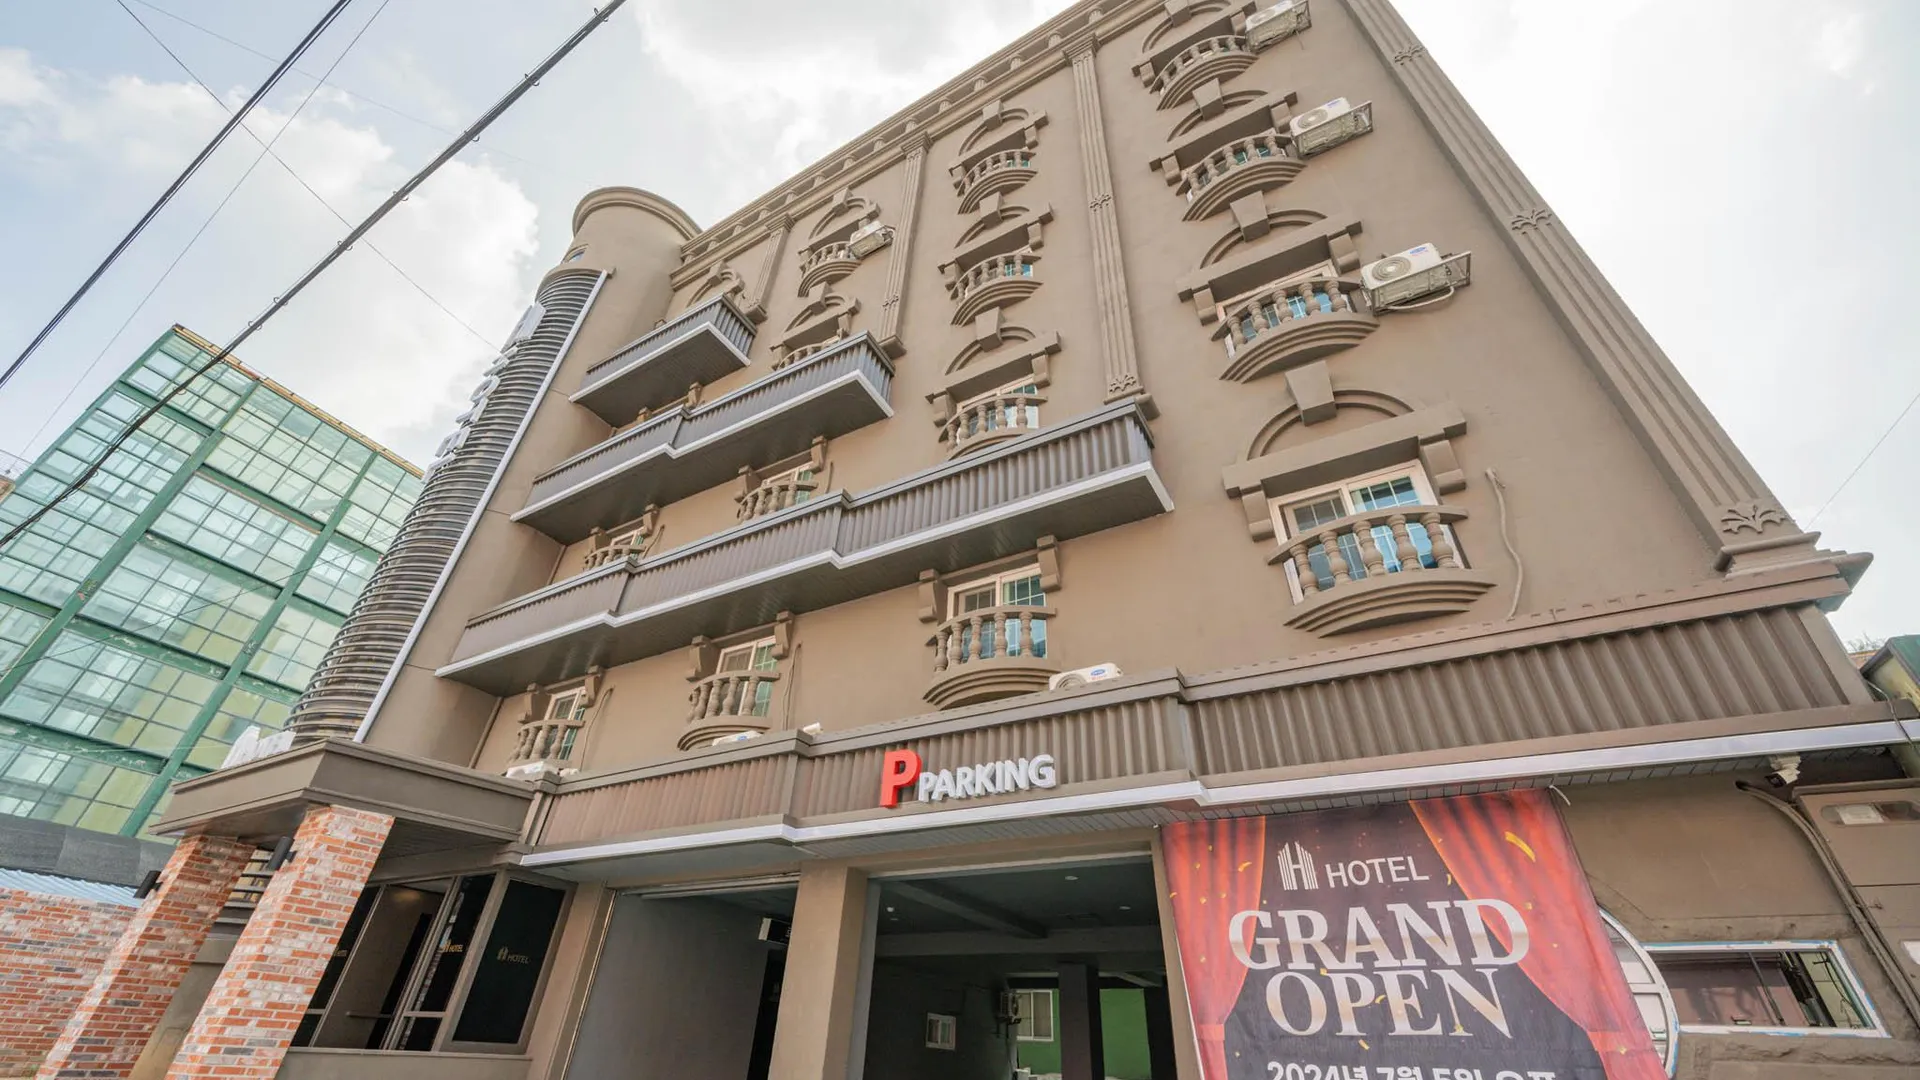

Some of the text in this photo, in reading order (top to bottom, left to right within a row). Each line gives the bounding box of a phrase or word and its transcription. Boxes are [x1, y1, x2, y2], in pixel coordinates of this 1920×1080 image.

[880, 749, 1057, 808] P PARKING
[1325, 855, 1430, 889] HOTEL
[1228, 898, 1530, 971] GRAND
[1265, 968, 1513, 1039] OPEN
